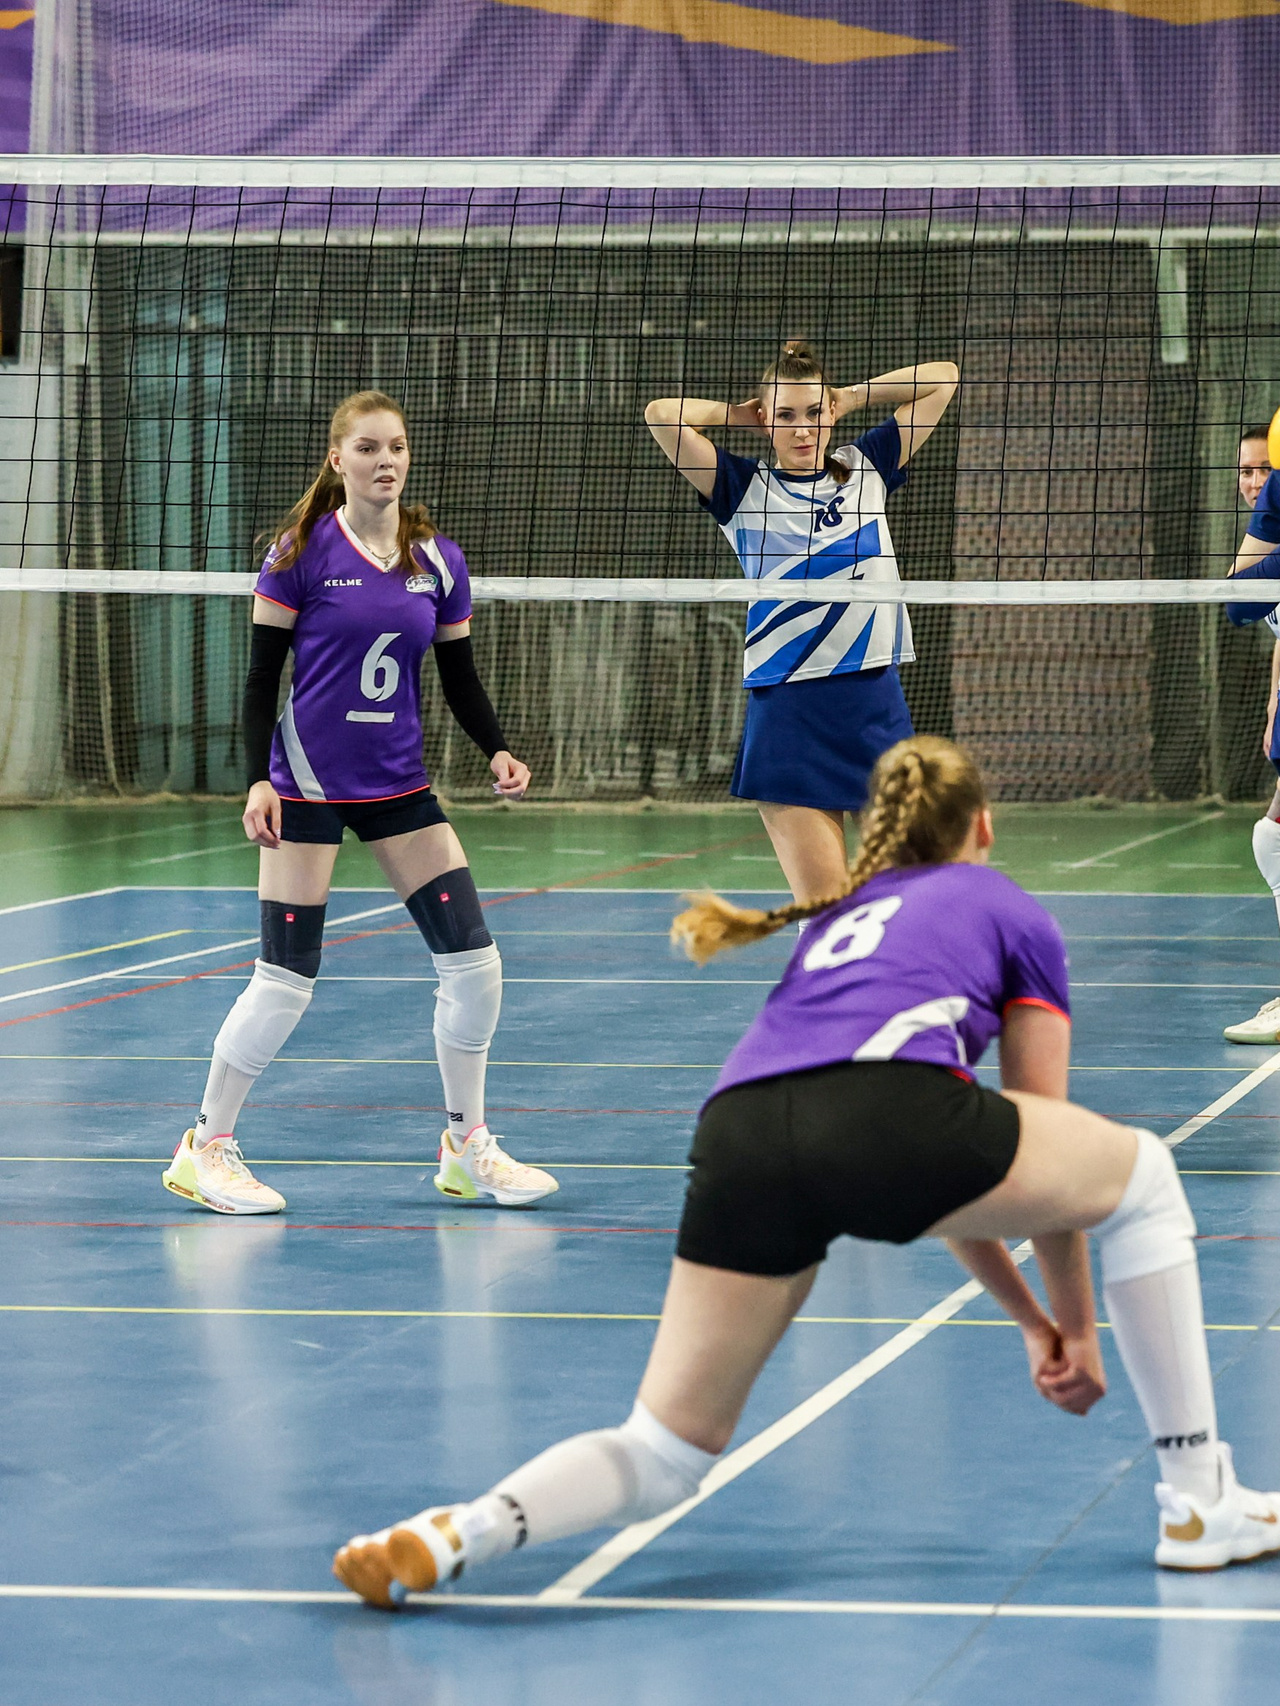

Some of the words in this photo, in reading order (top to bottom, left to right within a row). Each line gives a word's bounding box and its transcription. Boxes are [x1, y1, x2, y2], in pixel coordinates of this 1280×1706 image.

[324, 578, 363, 587] KELME
[360, 633, 402, 702] 6
[803, 896, 903, 972] 8
